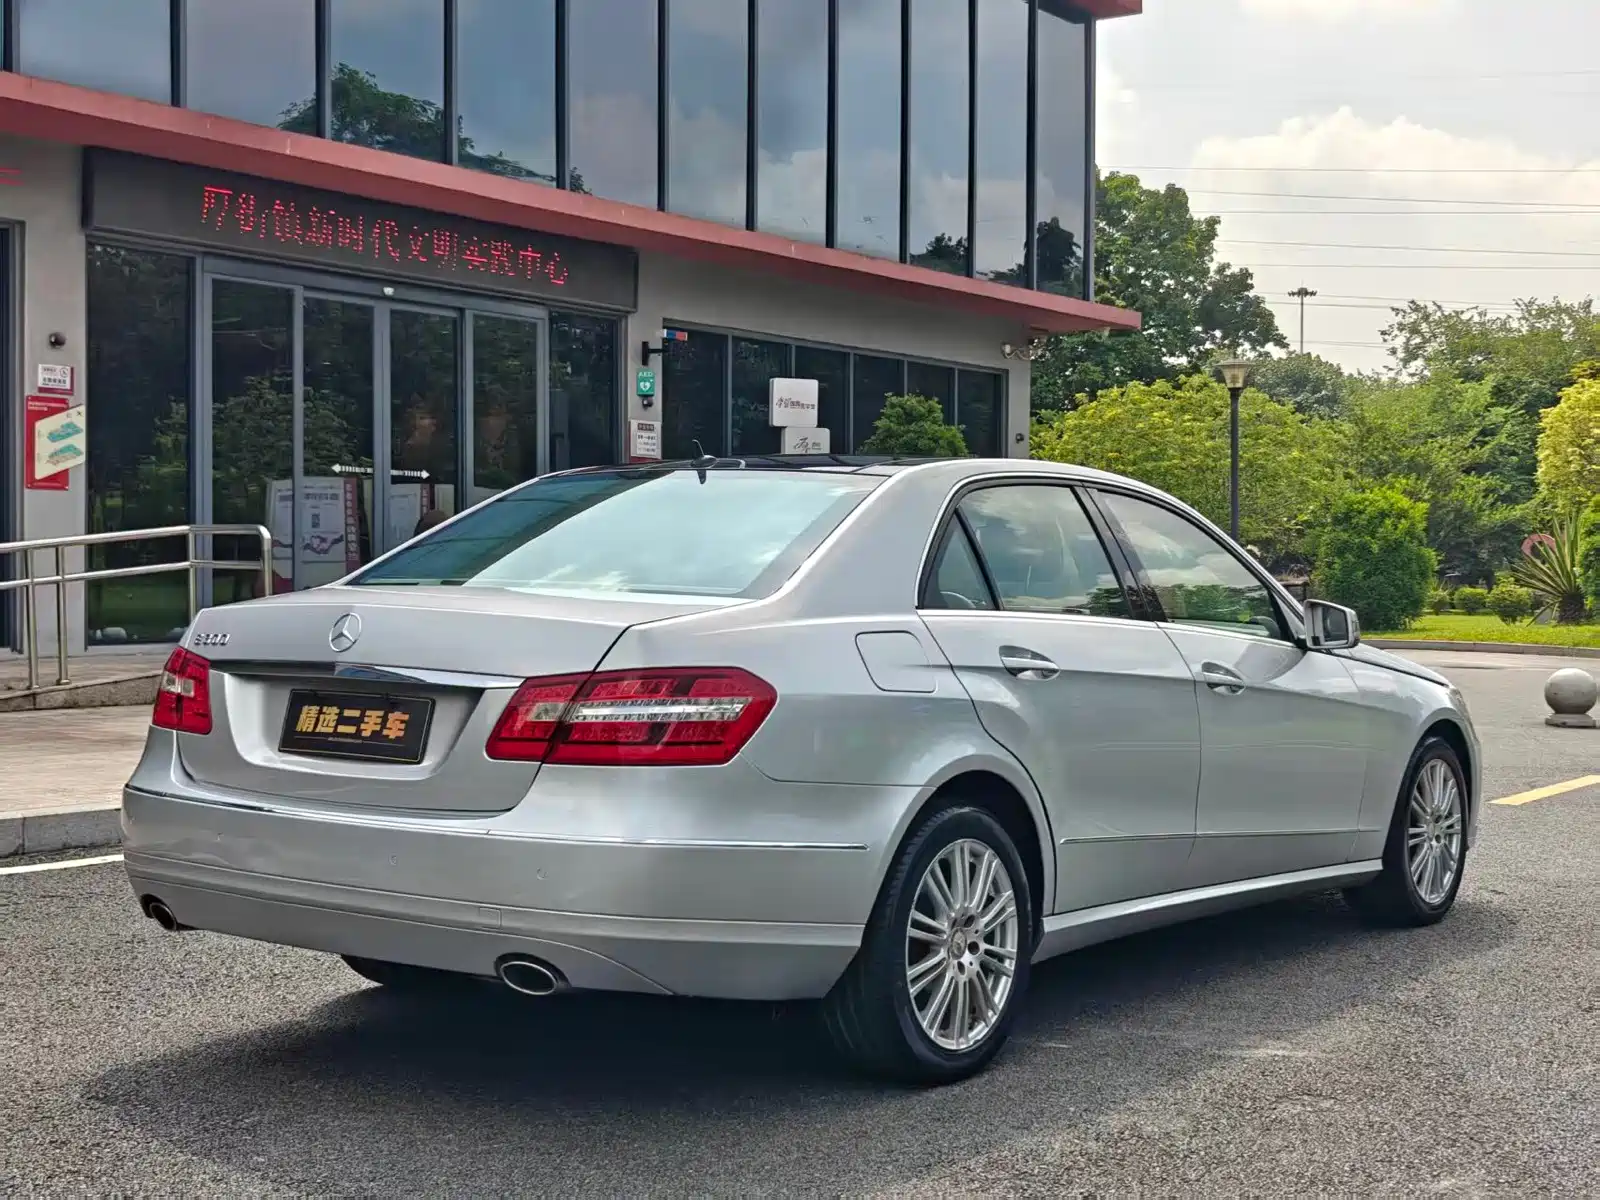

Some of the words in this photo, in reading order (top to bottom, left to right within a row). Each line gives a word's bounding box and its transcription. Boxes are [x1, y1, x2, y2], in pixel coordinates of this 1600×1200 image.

[638, 371, 653, 379] AED
[194, 633, 231, 646] E300
[295, 705, 410, 739] 精选二手车
